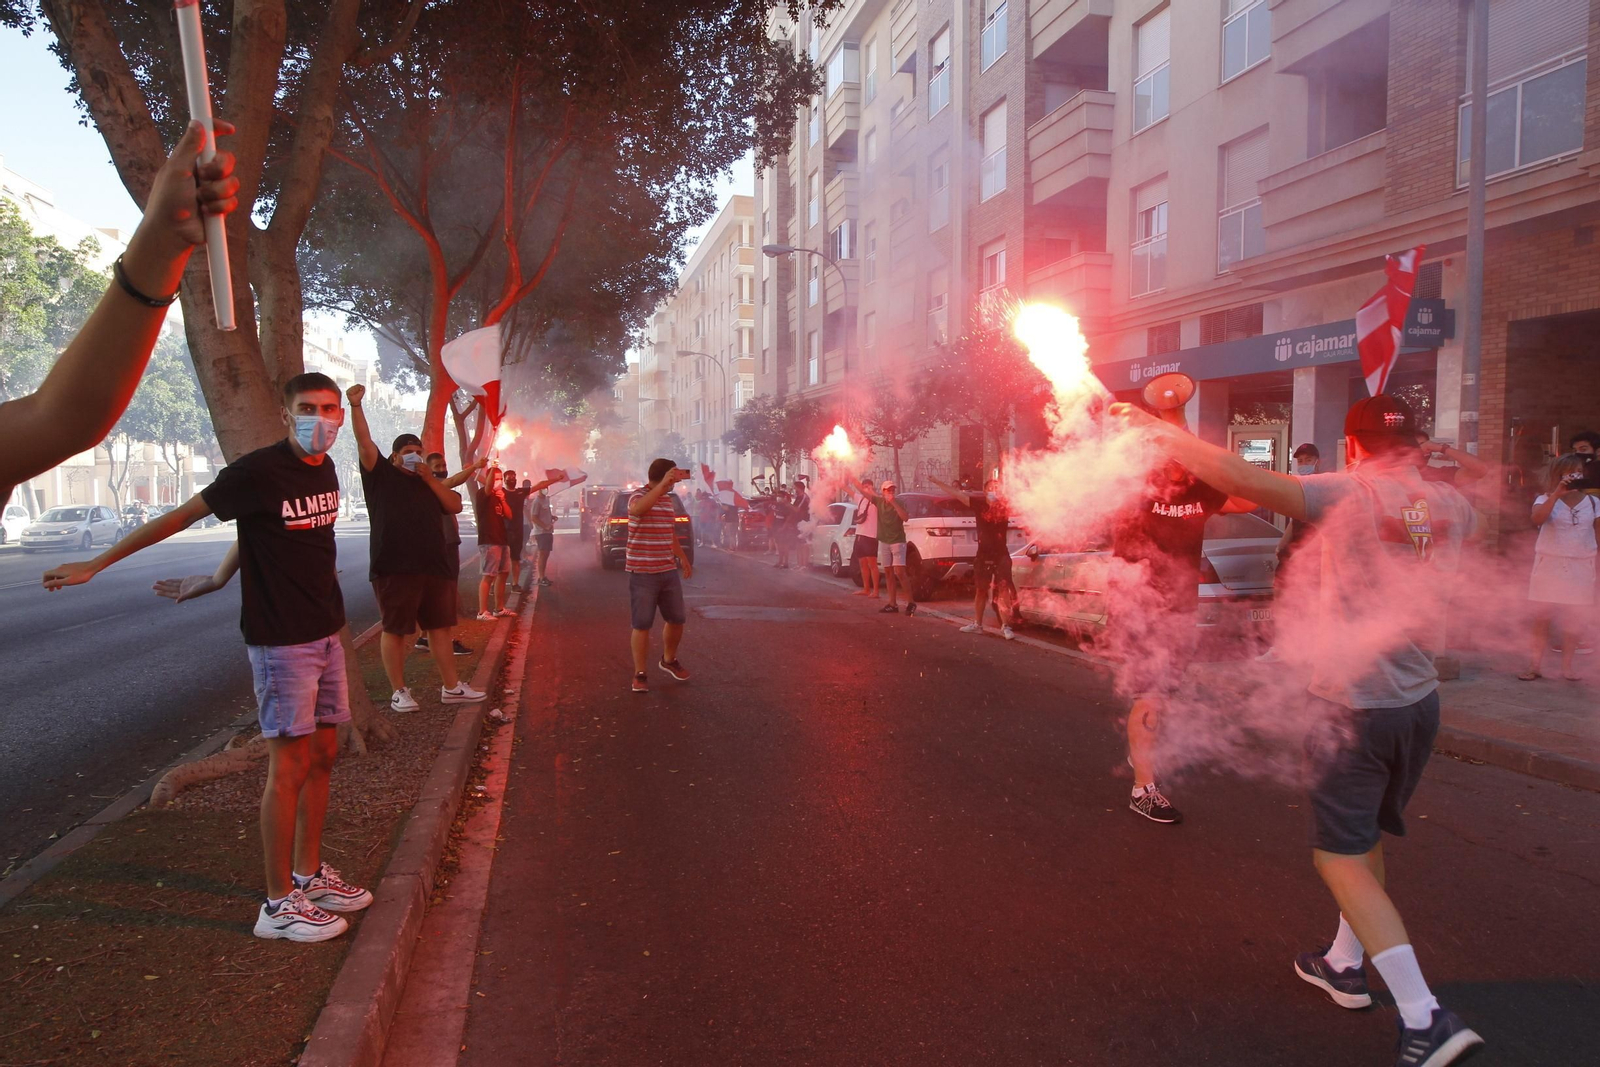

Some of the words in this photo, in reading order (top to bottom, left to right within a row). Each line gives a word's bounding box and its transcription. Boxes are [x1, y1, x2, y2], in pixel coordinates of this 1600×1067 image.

[1408, 326, 1441, 337] cajamar
[1295, 333, 1356, 359] cajamar
[1142, 361, 1181, 377] cajamar
[1151, 501, 1204, 518] ALMERIA
[310, 512, 333, 529] FIRM
